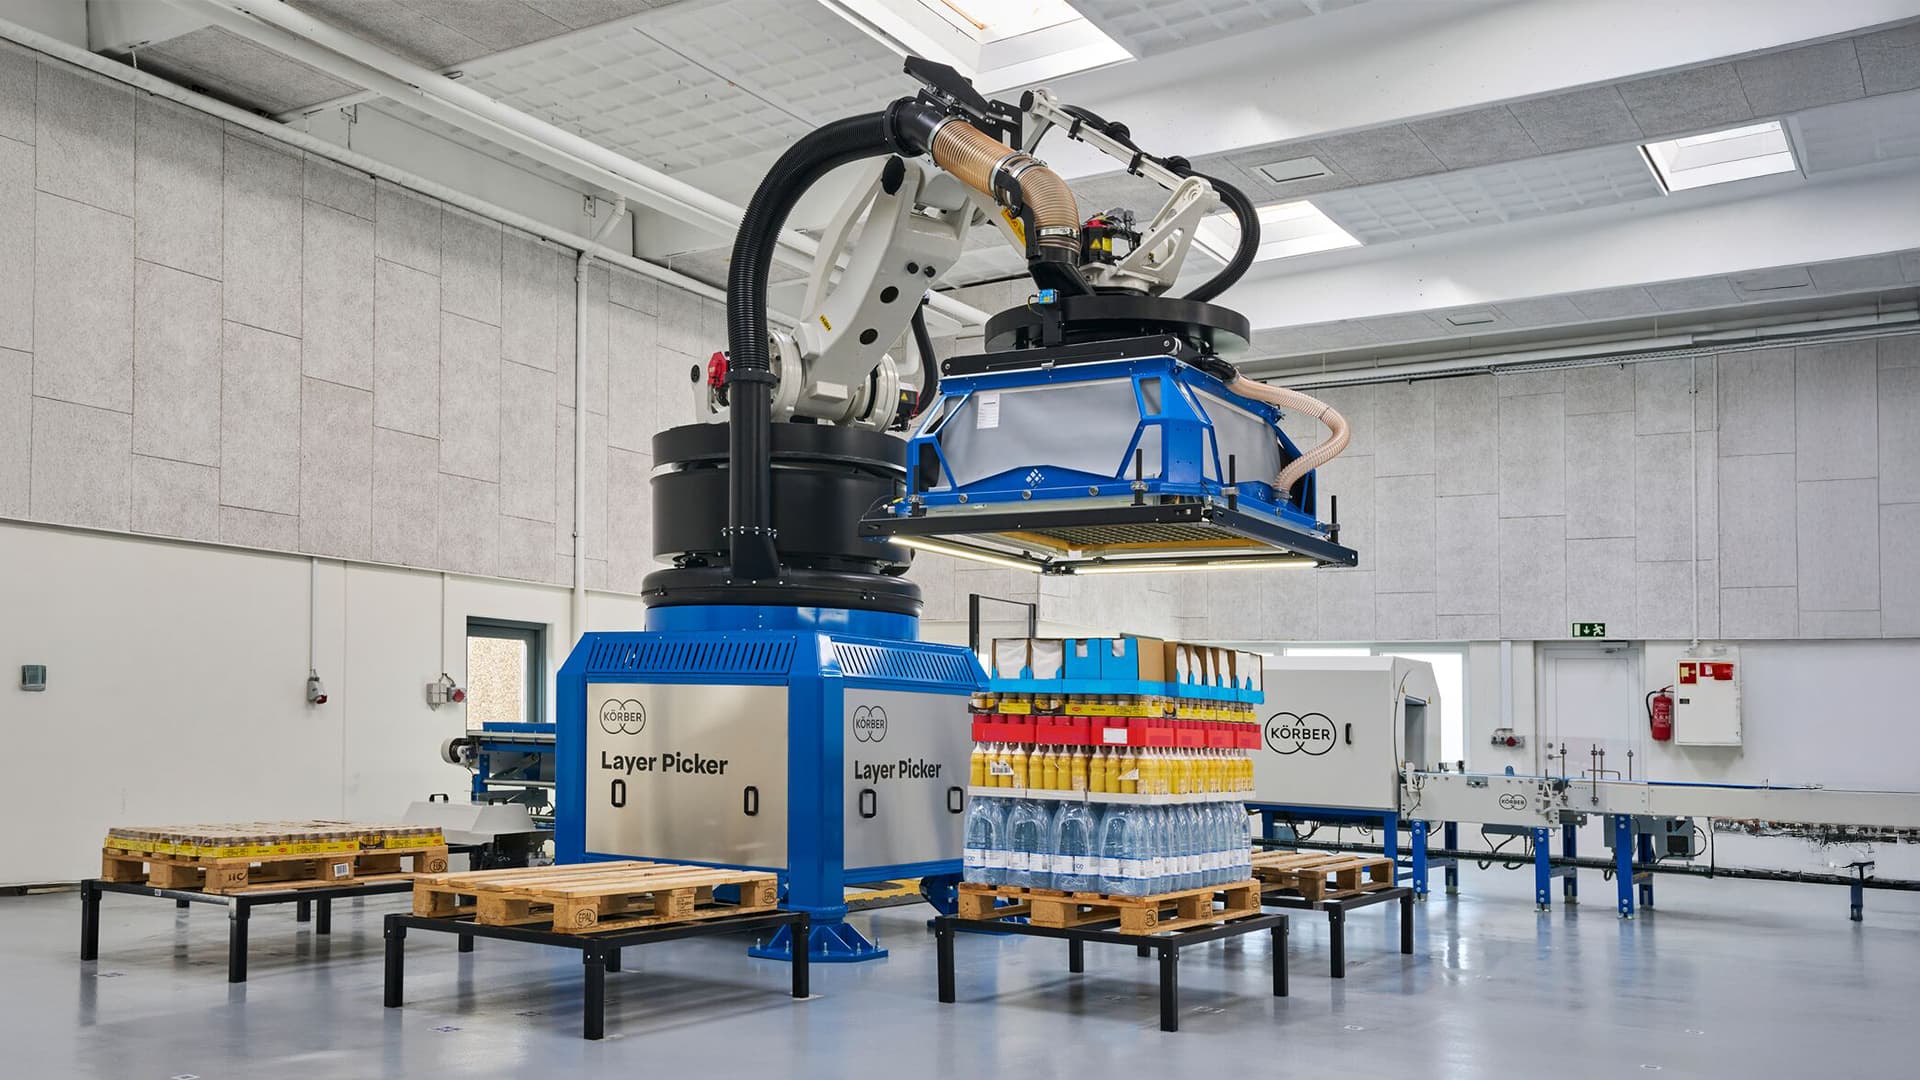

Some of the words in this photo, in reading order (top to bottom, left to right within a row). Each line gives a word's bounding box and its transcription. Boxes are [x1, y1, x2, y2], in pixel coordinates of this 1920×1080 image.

[603, 709, 643, 723] KÖRBER
[855, 716, 885, 730] KÖRBER
[1270, 724, 1332, 741] KÖRBER
[601, 750, 657, 775] Layer
[662, 752, 729, 776] Picker
[854, 759, 896, 785] Layer
[898, 758, 942, 779] Picker
[1501, 796, 1525, 806] KÖRBER
